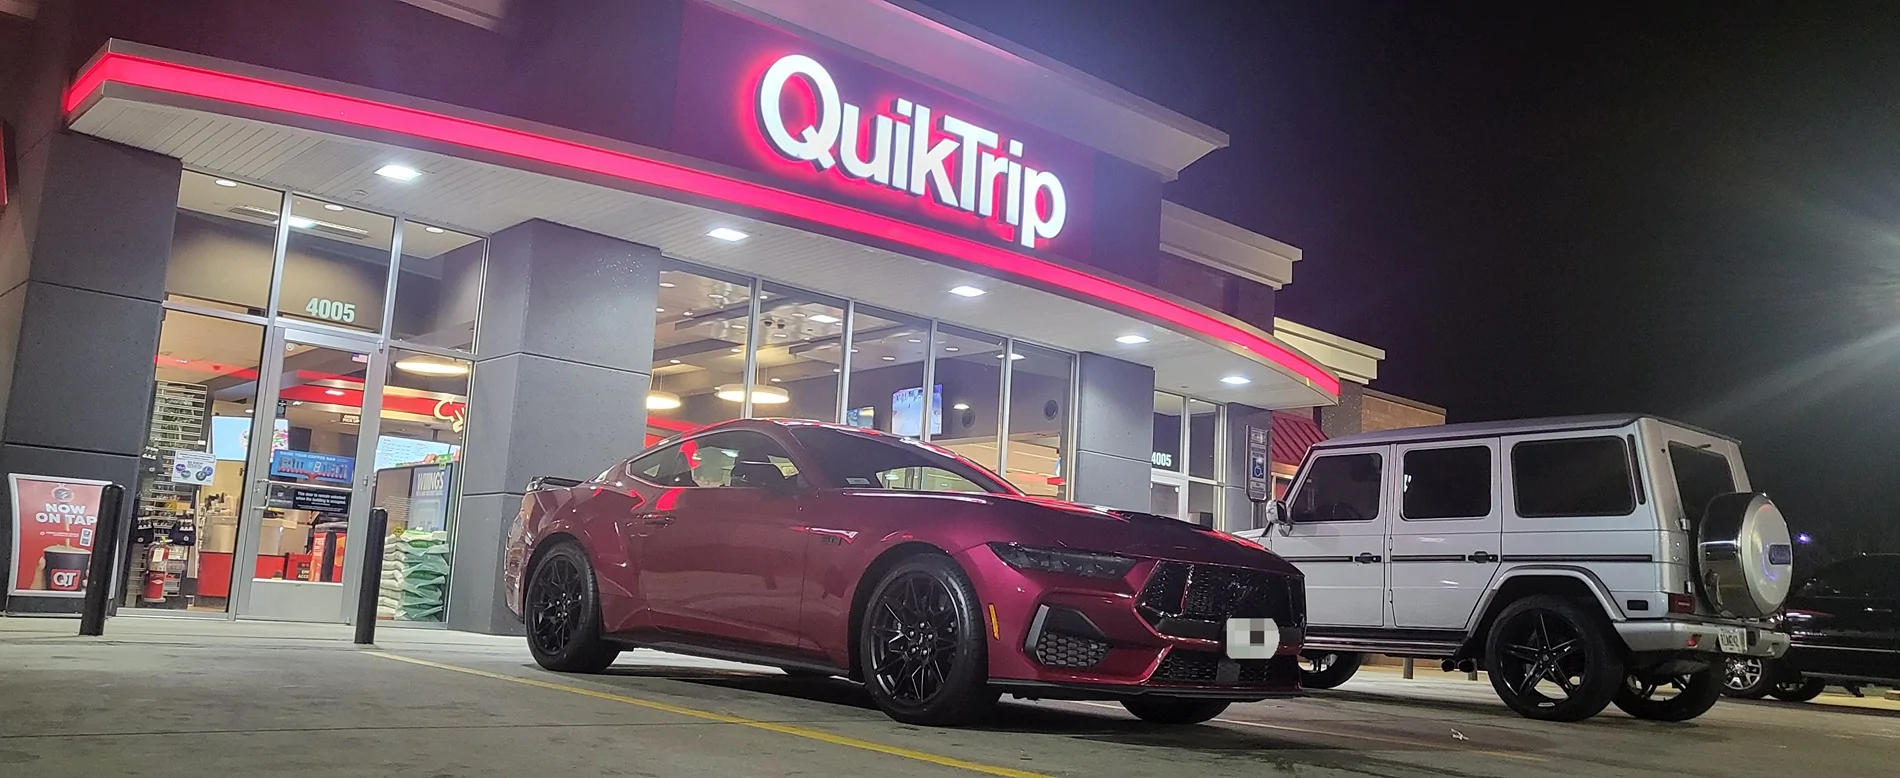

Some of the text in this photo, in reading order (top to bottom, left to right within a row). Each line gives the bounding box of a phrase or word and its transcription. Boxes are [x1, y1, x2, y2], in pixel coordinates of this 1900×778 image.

[759, 53, 1066, 249] QuikTrip
[305, 297, 356, 323] 4005
[1151, 451, 1172, 468] 4005
[45, 503, 86, 515] NOW
[35, 512, 98, 526] ON TAP
[53, 571, 77, 587] QT
